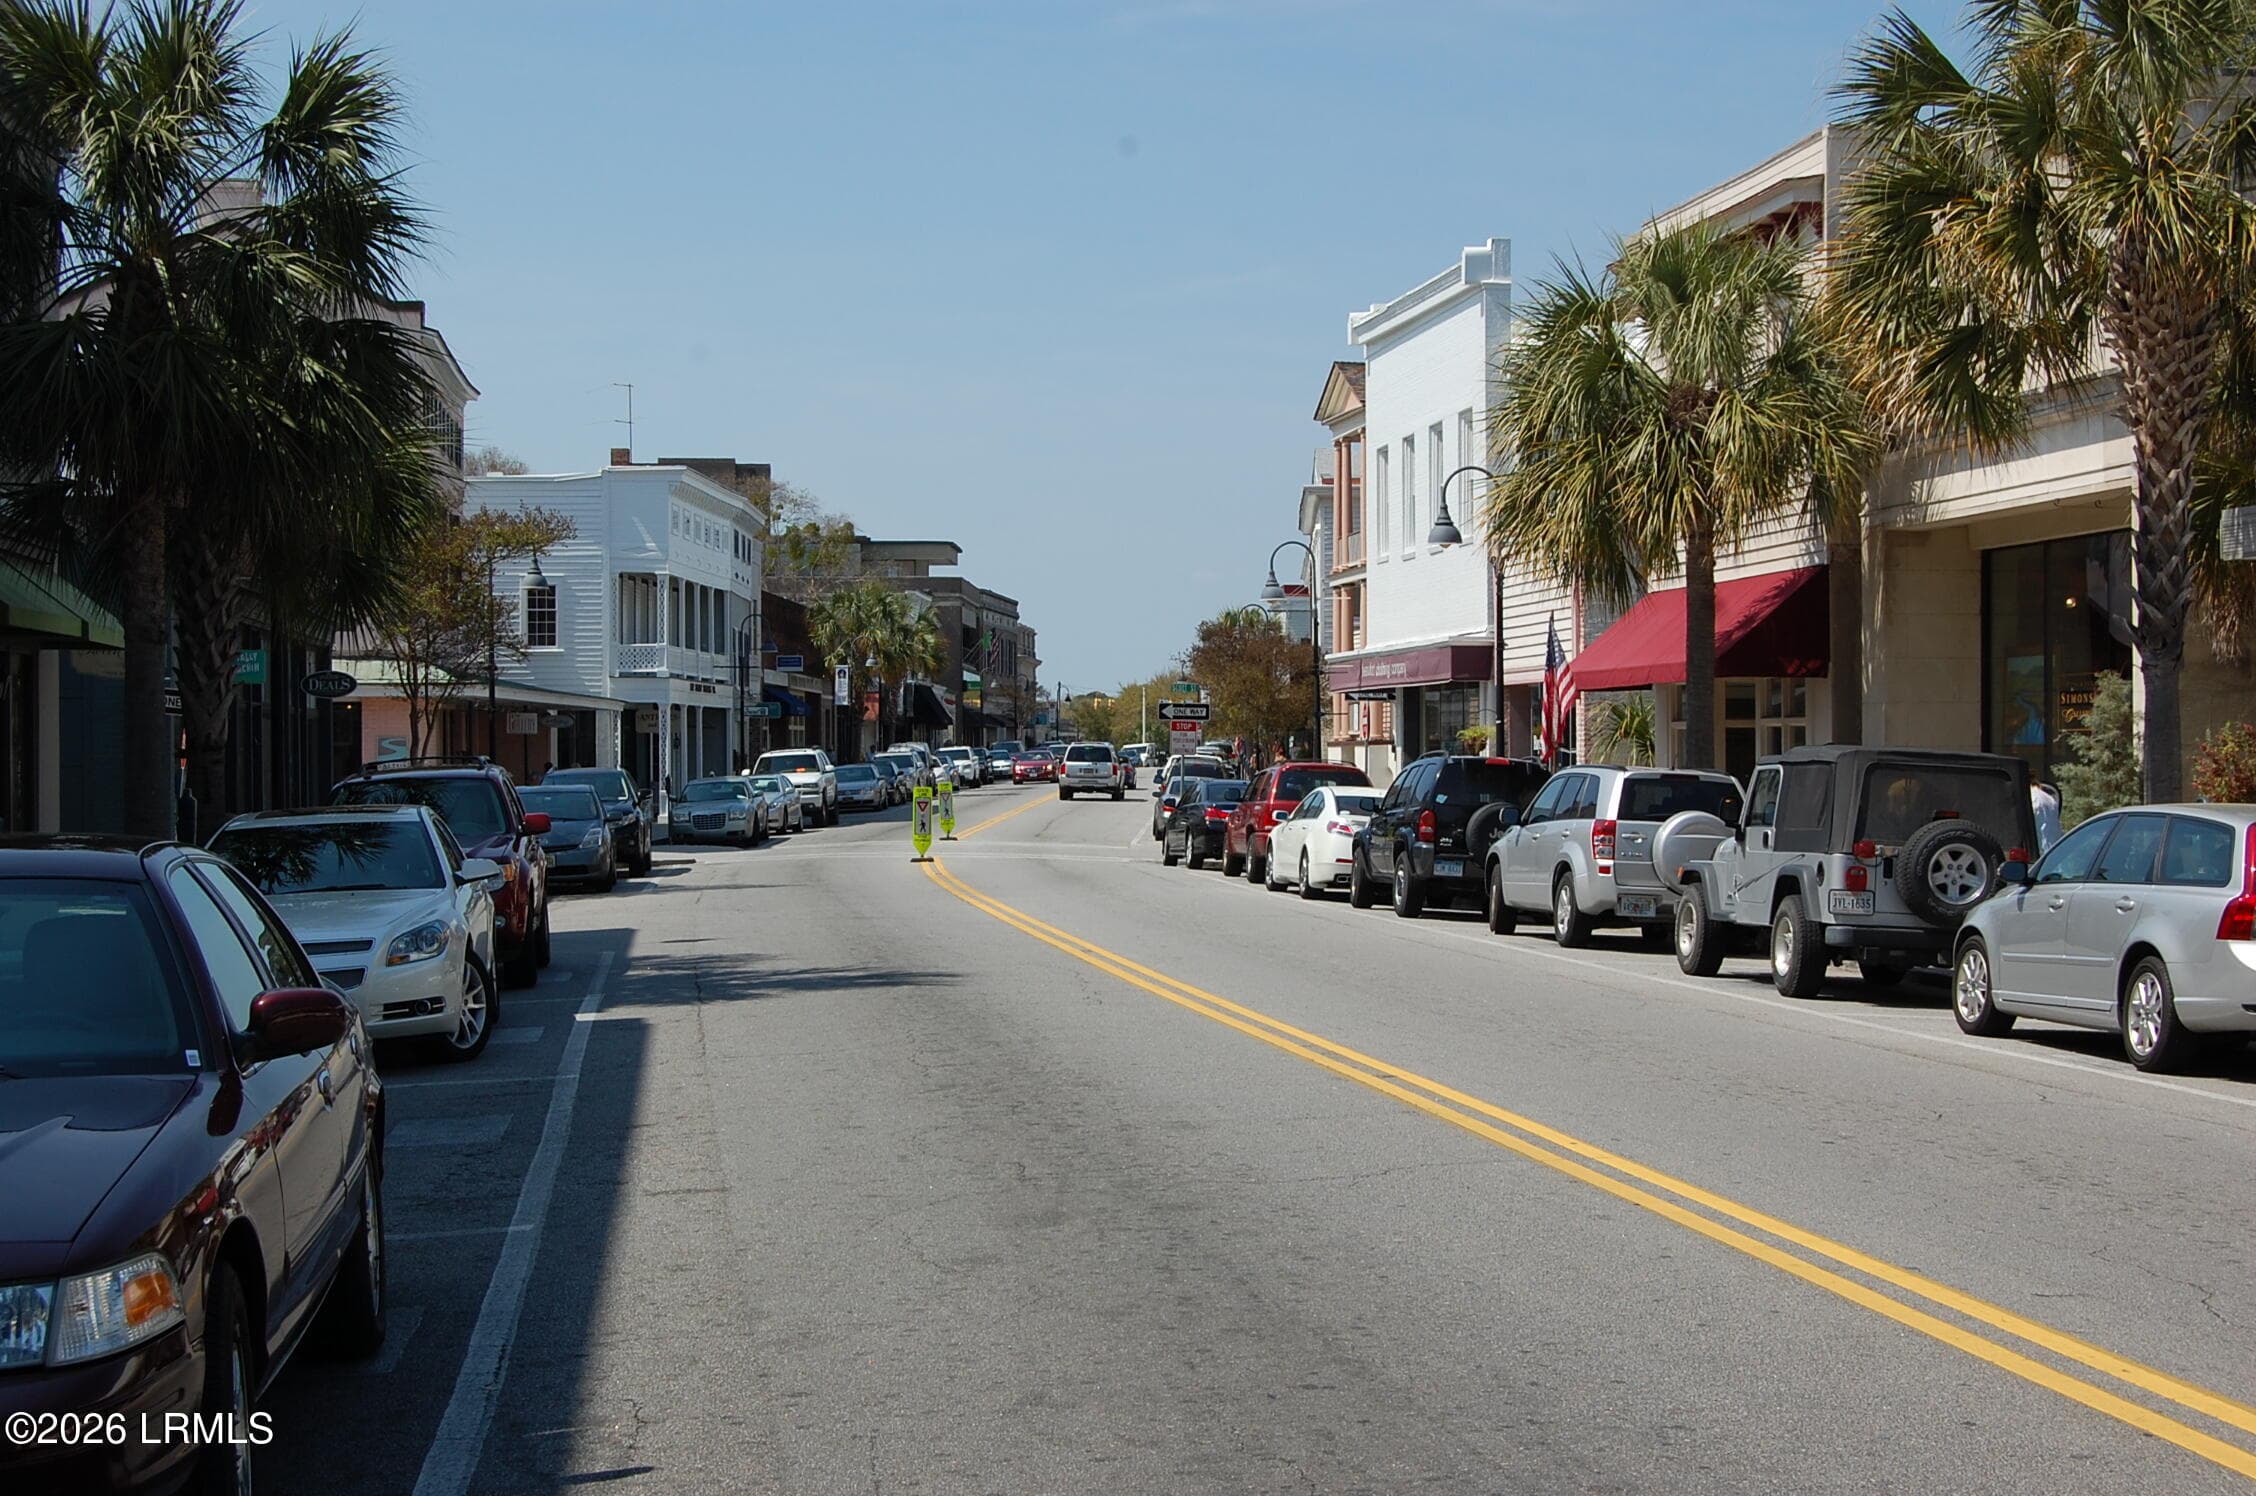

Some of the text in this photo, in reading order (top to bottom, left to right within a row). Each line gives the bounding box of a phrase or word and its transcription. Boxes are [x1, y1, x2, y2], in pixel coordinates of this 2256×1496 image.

[309, 679, 351, 691] DEALS
[1173, 707, 1204, 716] ONE WAY
[1176, 722, 1193, 731] STOP
